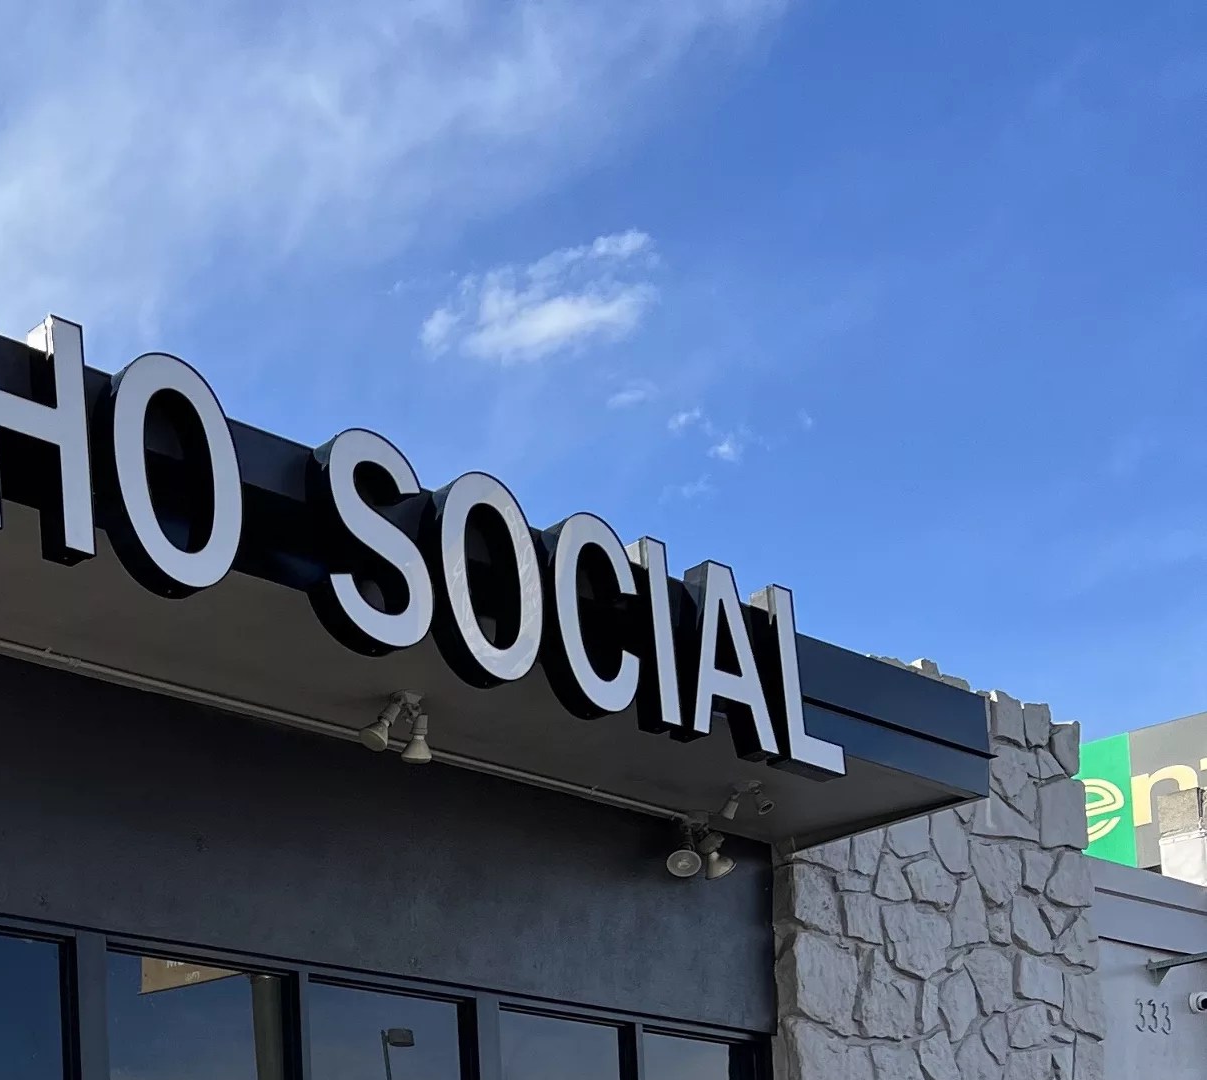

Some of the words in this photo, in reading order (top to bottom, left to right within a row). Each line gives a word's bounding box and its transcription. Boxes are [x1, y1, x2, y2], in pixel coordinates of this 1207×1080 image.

[329, 427, 846, 777] SOCIAL
[1078, 757, 1207, 843] en
[1135, 998, 1172, 1035] 333
